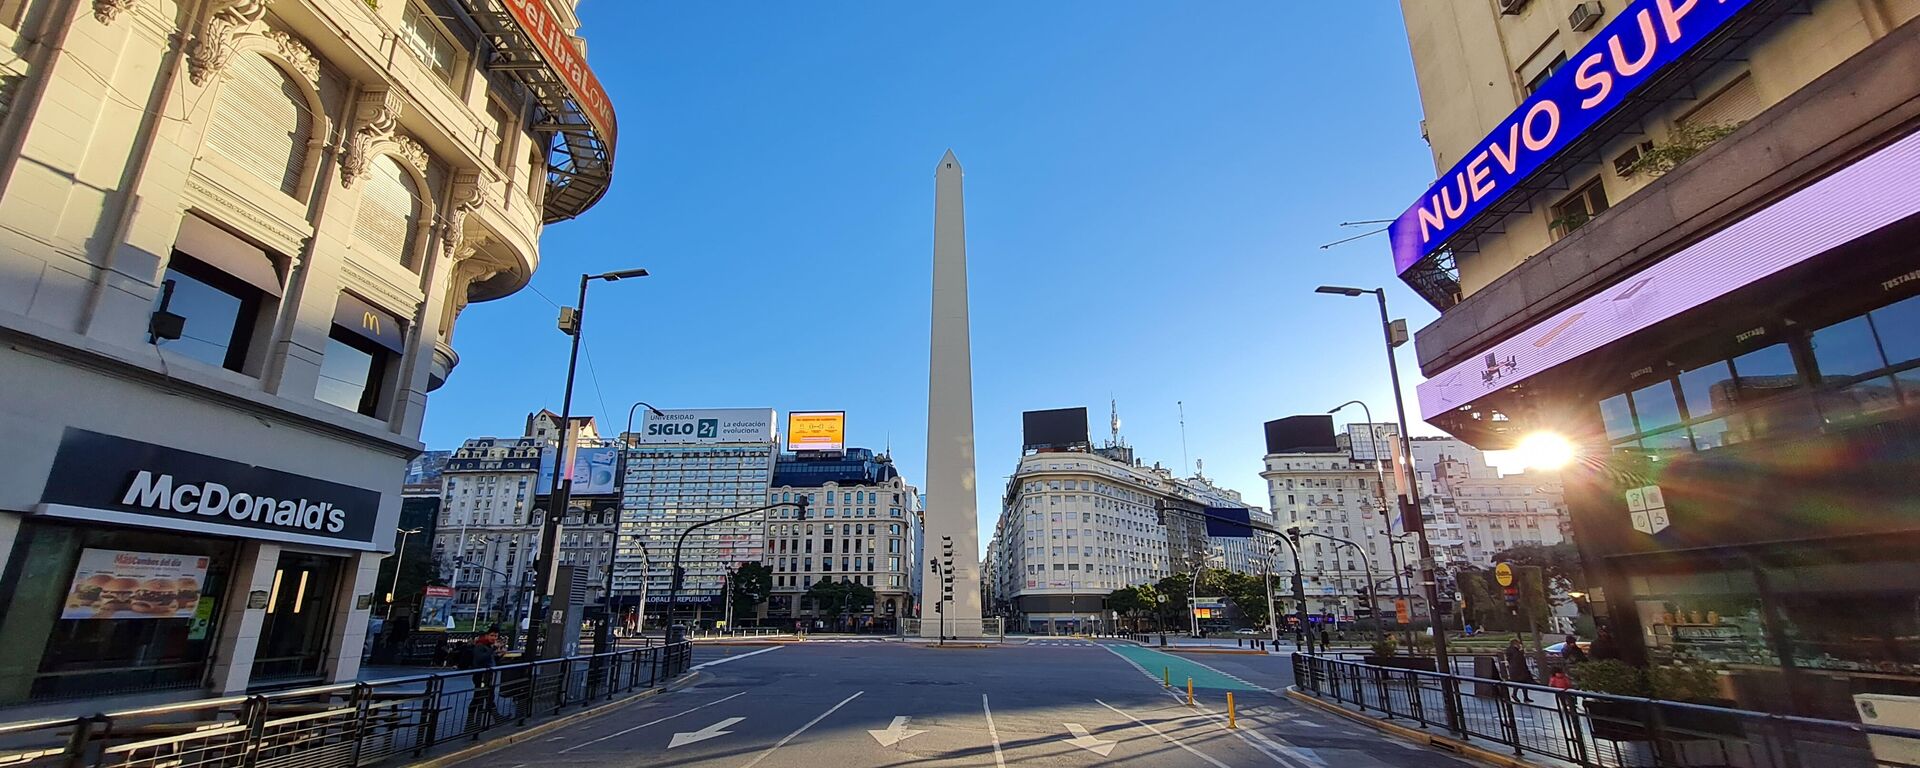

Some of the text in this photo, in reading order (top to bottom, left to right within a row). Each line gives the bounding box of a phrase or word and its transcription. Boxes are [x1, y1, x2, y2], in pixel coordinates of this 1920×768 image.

[1418, 0, 1726, 243] NUEVO SUP
[648, 423, 694, 436] SIGLO
[699, 422, 717, 437] 21
[122, 470, 345, 532] McDonald's
